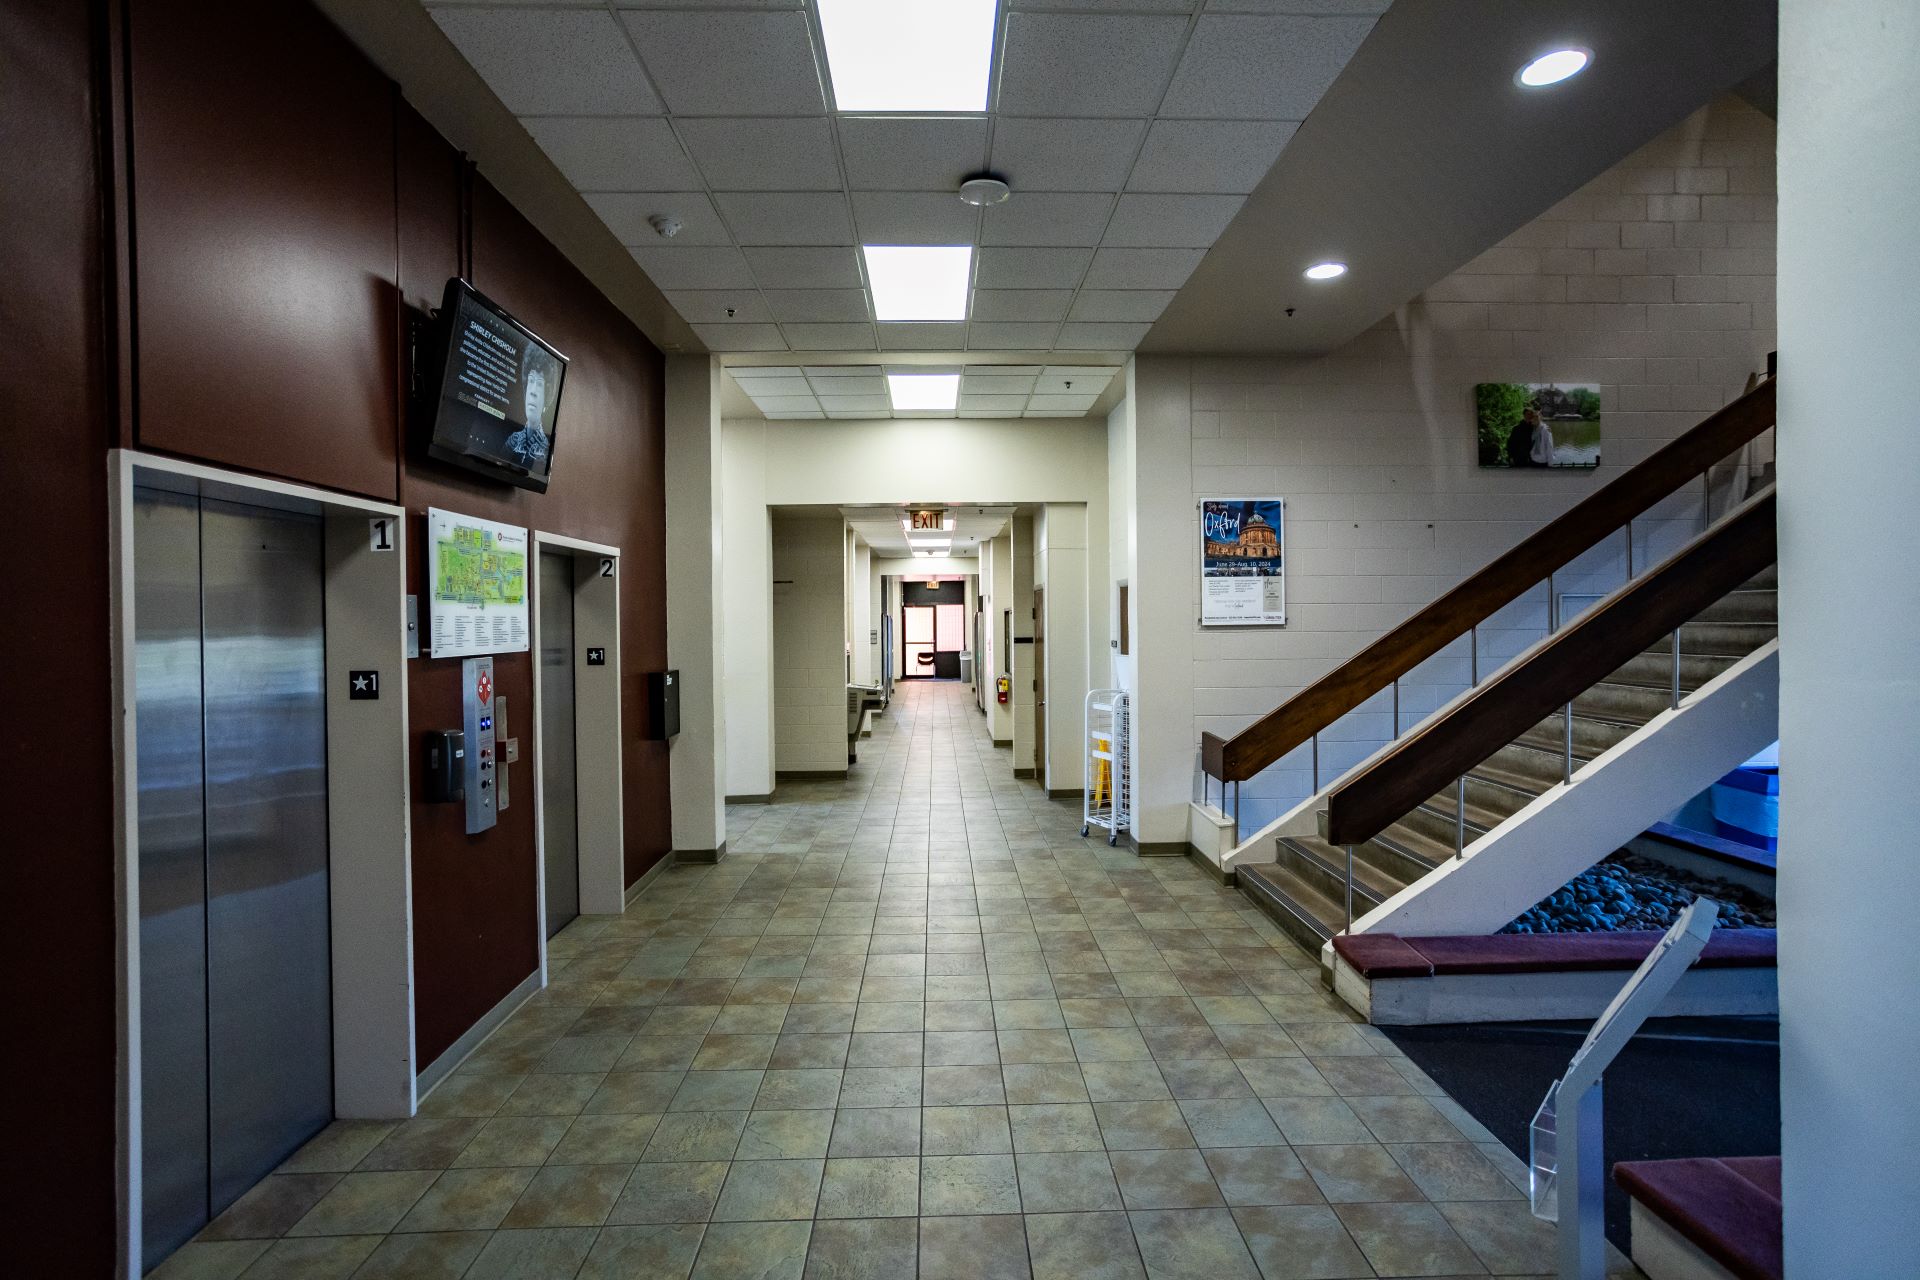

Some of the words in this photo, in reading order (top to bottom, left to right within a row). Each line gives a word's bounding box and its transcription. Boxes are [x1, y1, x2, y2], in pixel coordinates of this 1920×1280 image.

[470, 320, 492, 339] SHIRLEY
[491, 335, 517, 356] CHISHOLM
[913, 513, 940, 529] EXIT
[1205, 512, 1240, 539] Oxford
[374, 520, 391, 549] 1
[602, 559, 613, 577] 2
[598, 650, 603, 660] 1
[370, 674, 376, 690] 1
